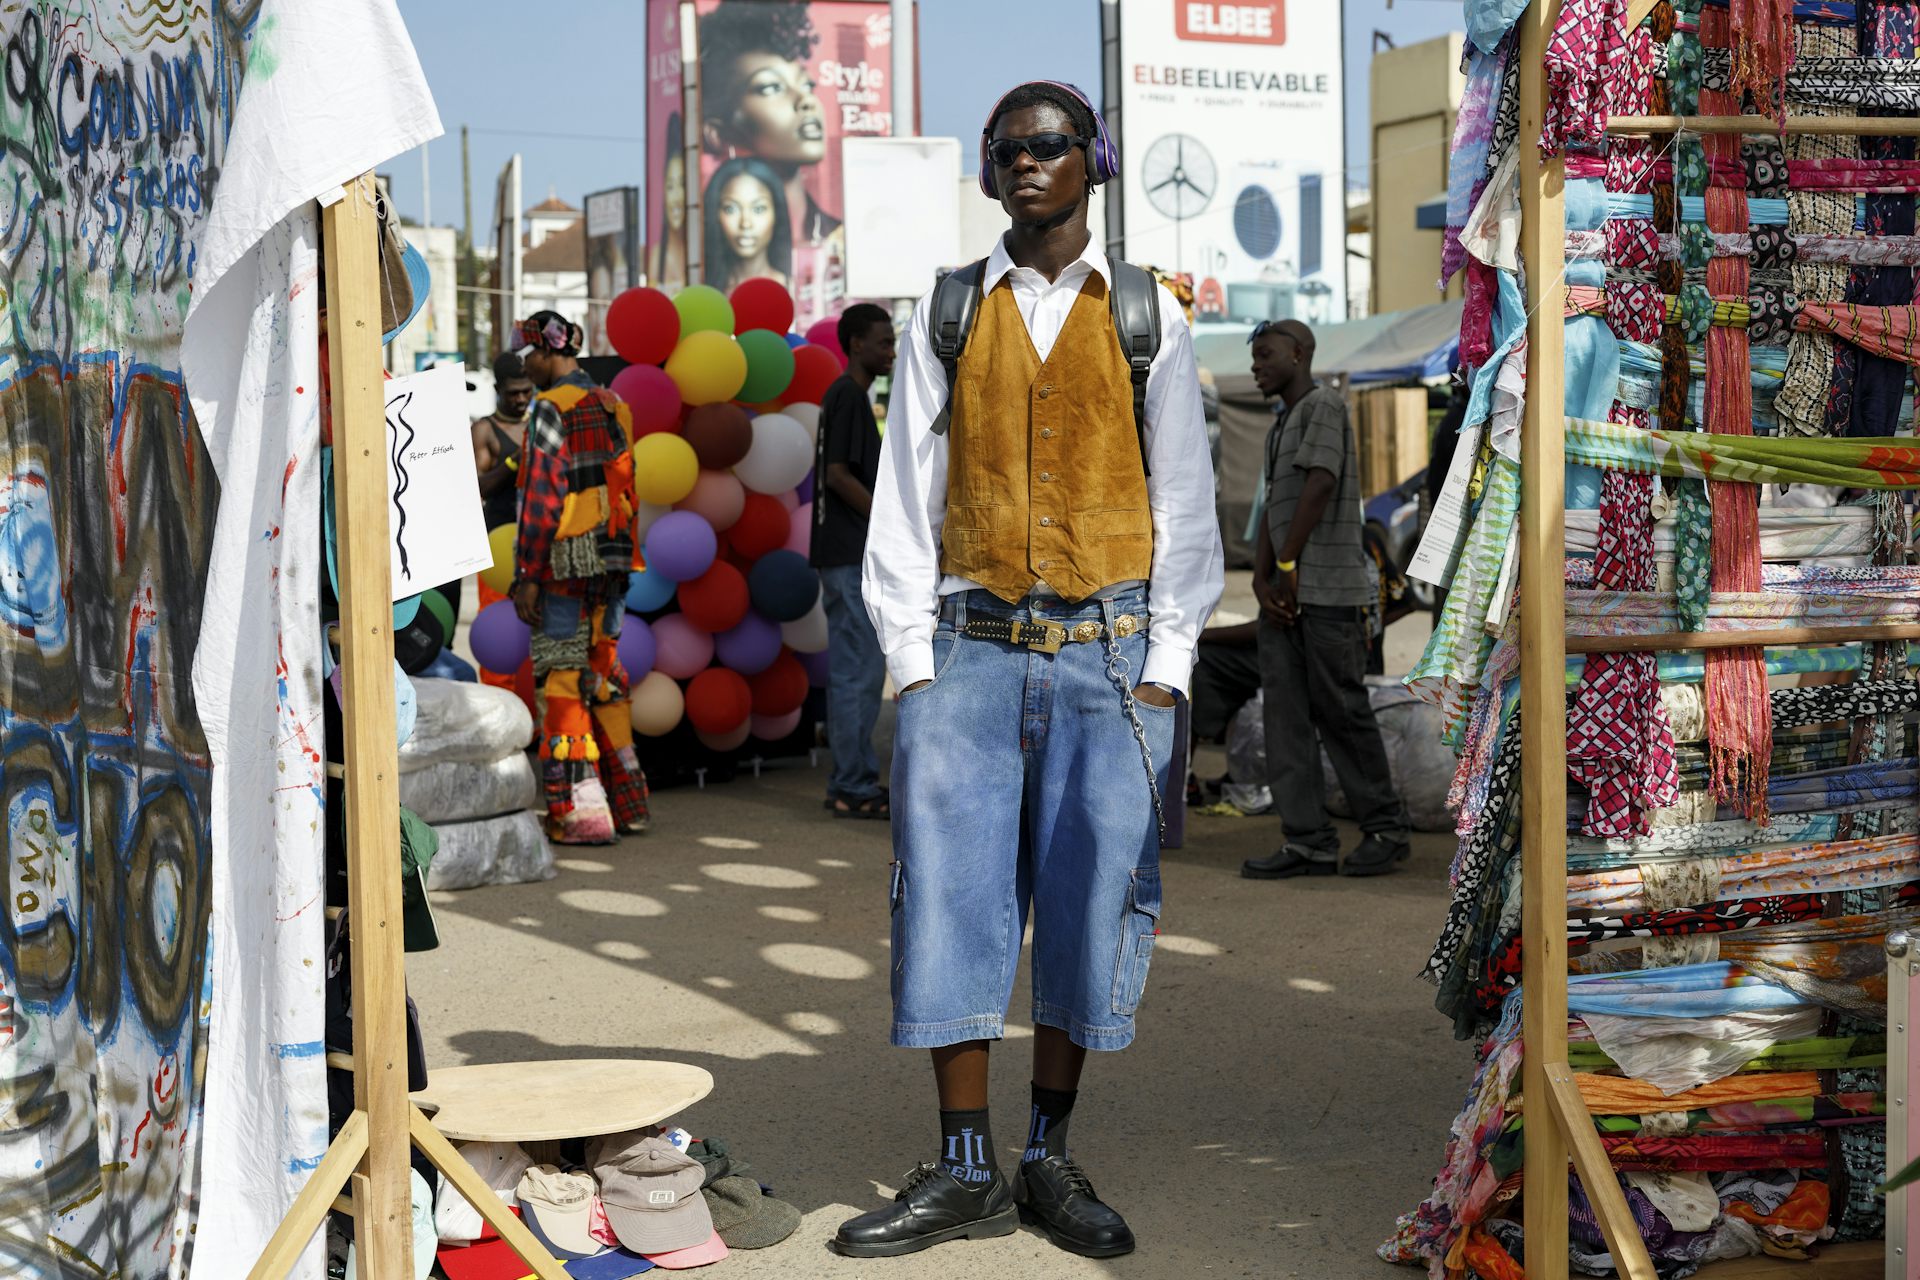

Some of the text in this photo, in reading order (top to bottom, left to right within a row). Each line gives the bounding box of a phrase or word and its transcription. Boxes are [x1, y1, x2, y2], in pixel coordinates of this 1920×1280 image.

[1186, 2, 1273, 37] ELBEE
[818, 60, 884, 91] Style
[1133, 63, 1329, 94] ELBEELIEVABLE
